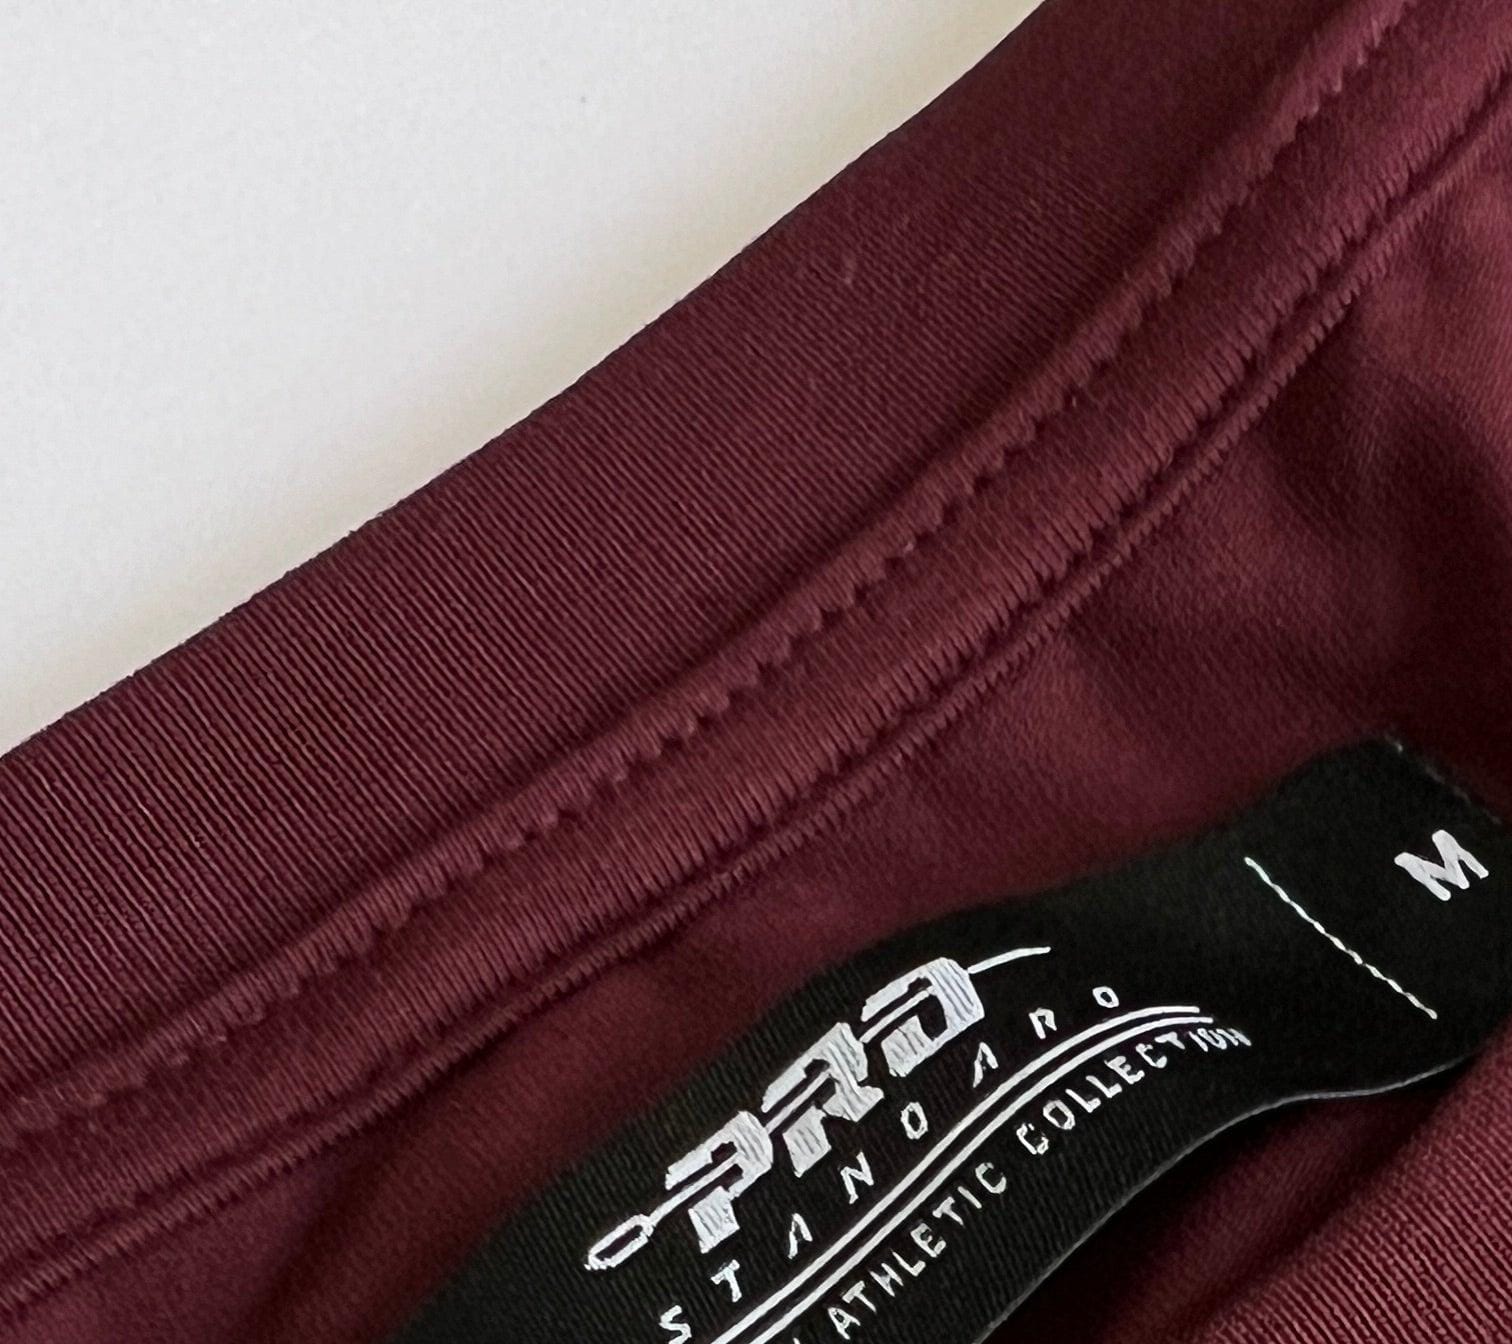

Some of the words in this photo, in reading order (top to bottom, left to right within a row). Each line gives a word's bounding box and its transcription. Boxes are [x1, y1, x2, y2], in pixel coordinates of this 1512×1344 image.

[1394, 829, 1489, 901] M
[664, 956, 986, 1254] PRO
[827, 1162, 1008, 1340] ATHLETIC
[1015, 1027, 1252, 1155] COLLECTION
